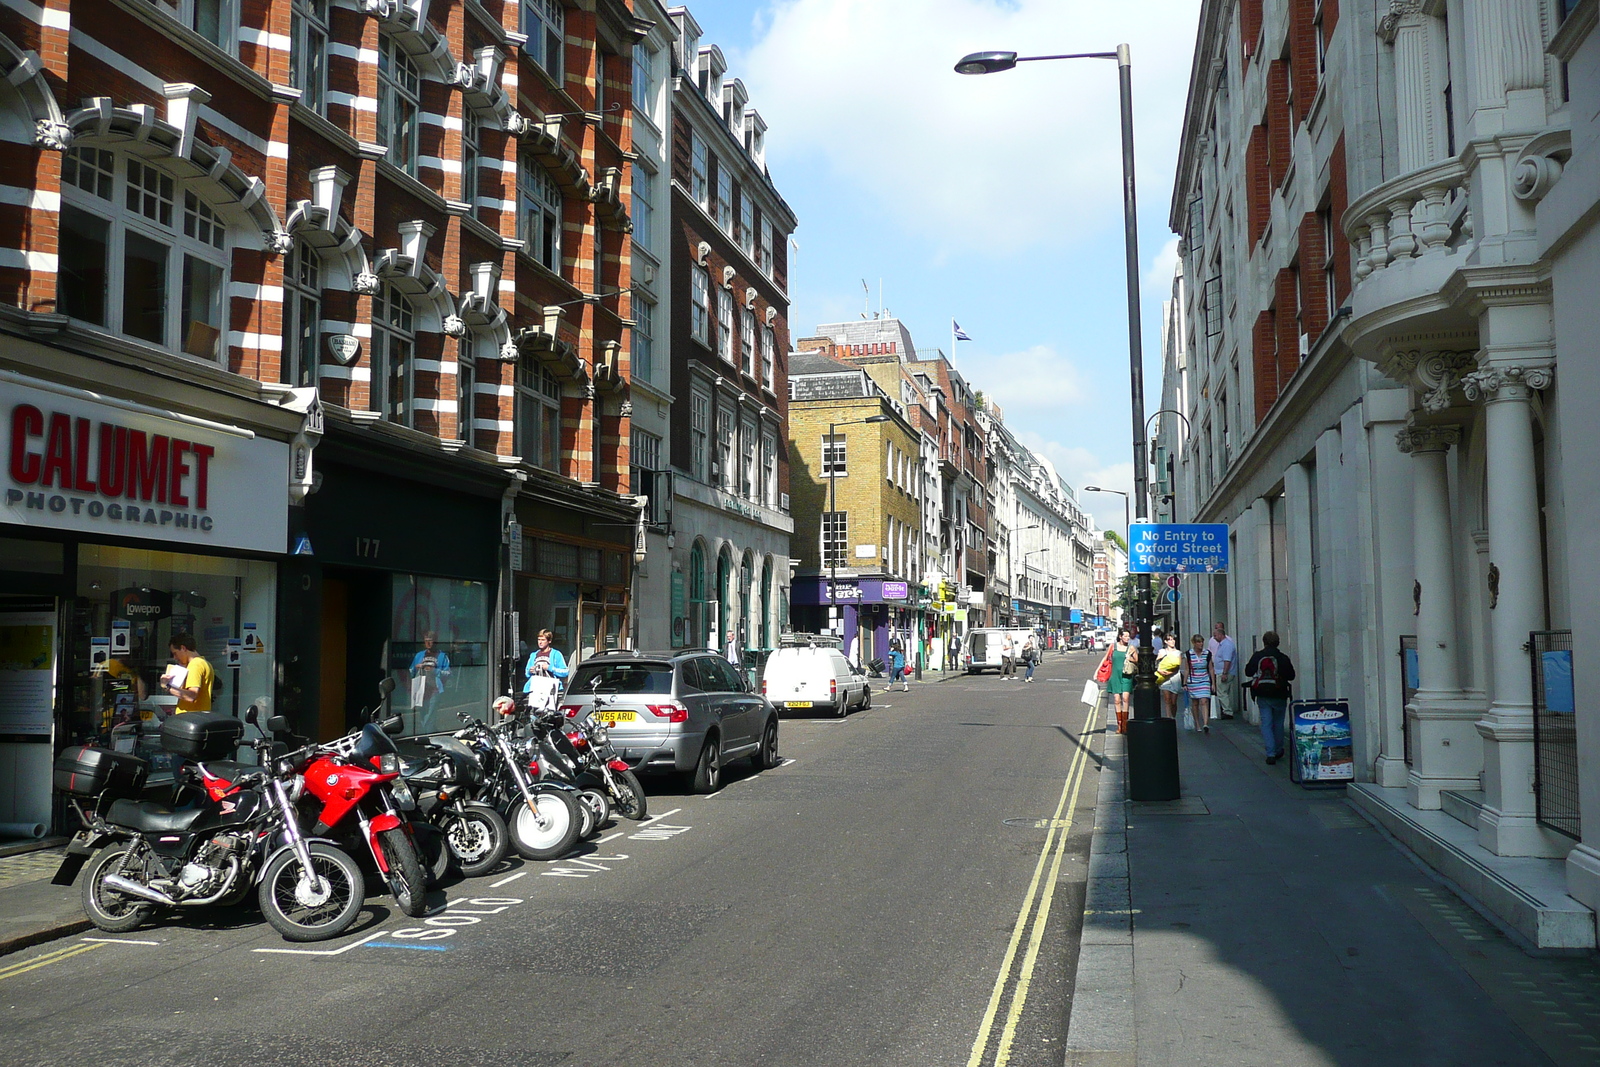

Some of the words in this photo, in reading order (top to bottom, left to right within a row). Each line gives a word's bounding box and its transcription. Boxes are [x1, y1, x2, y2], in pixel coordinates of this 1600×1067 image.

[9, 403, 215, 510] CALUMET
[6, 488, 213, 531] PHOTOGRAPHIC
[1142, 530, 1159, 541] No
[1164, 530, 1198, 543] Entry
[1202, 531, 1215, 541] to
[355, 536, 381, 559] 177
[1135, 543, 1178, 553] Oxford
[1182, 543, 1222, 553] Street
[1139, 555, 1178, 567] 50yds
[1181, 555, 1219, 566] ahead
[126, 603, 161, 616] Lowepro
[617, 712, 633, 721] ARU
[391, 897, 524, 941] SOLO
[628, 823, 692, 841] ONLY
